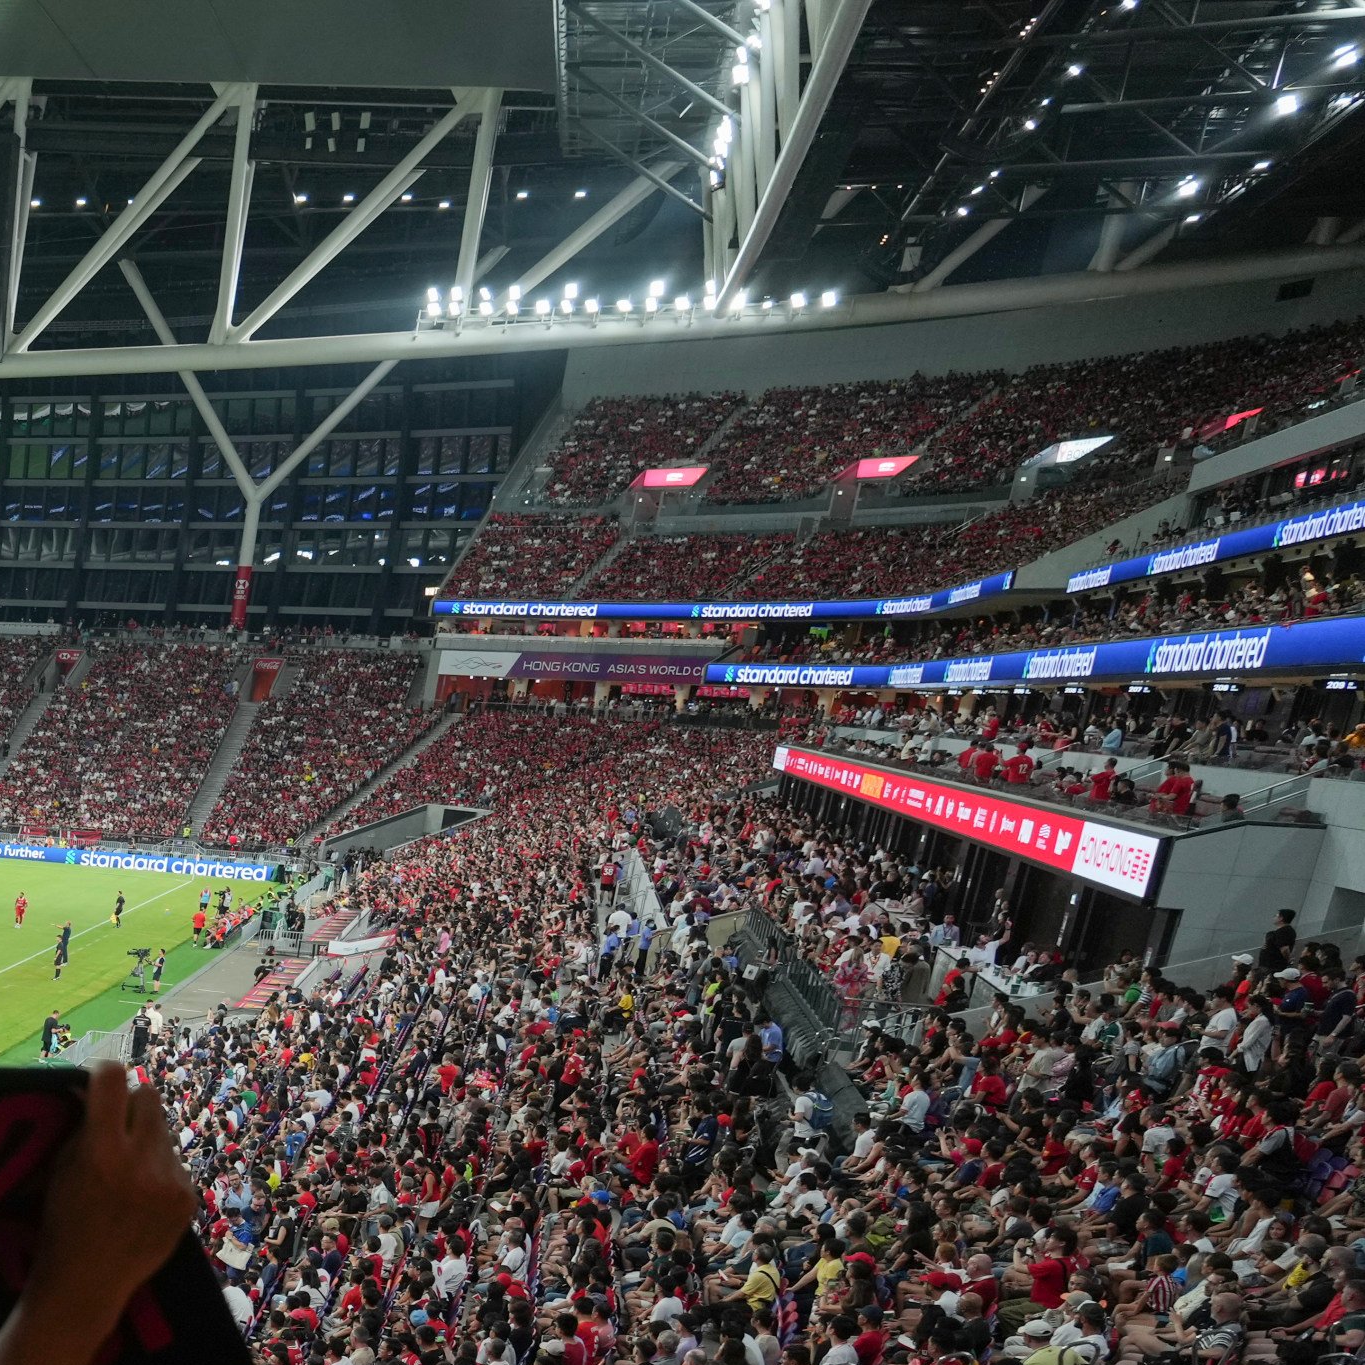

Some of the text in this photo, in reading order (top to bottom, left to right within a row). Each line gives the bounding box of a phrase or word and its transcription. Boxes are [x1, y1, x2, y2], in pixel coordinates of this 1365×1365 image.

[1281, 511, 1327, 547] standard
[463, 603, 597, 617] standard chartered
[702, 603, 813, 618] standard chartered
[1152, 628, 1271, 672] standard chartered
[523, 660, 561, 673] HONG
[563, 661, 601, 674] KONG
[607, 664, 647, 675] ASIA'S
[652, 665, 690, 675] WORLD
[737, 666, 853, 685] standard chartered
[4, 845, 46, 860] further.
[80, 852, 268, 881] standard chartered
